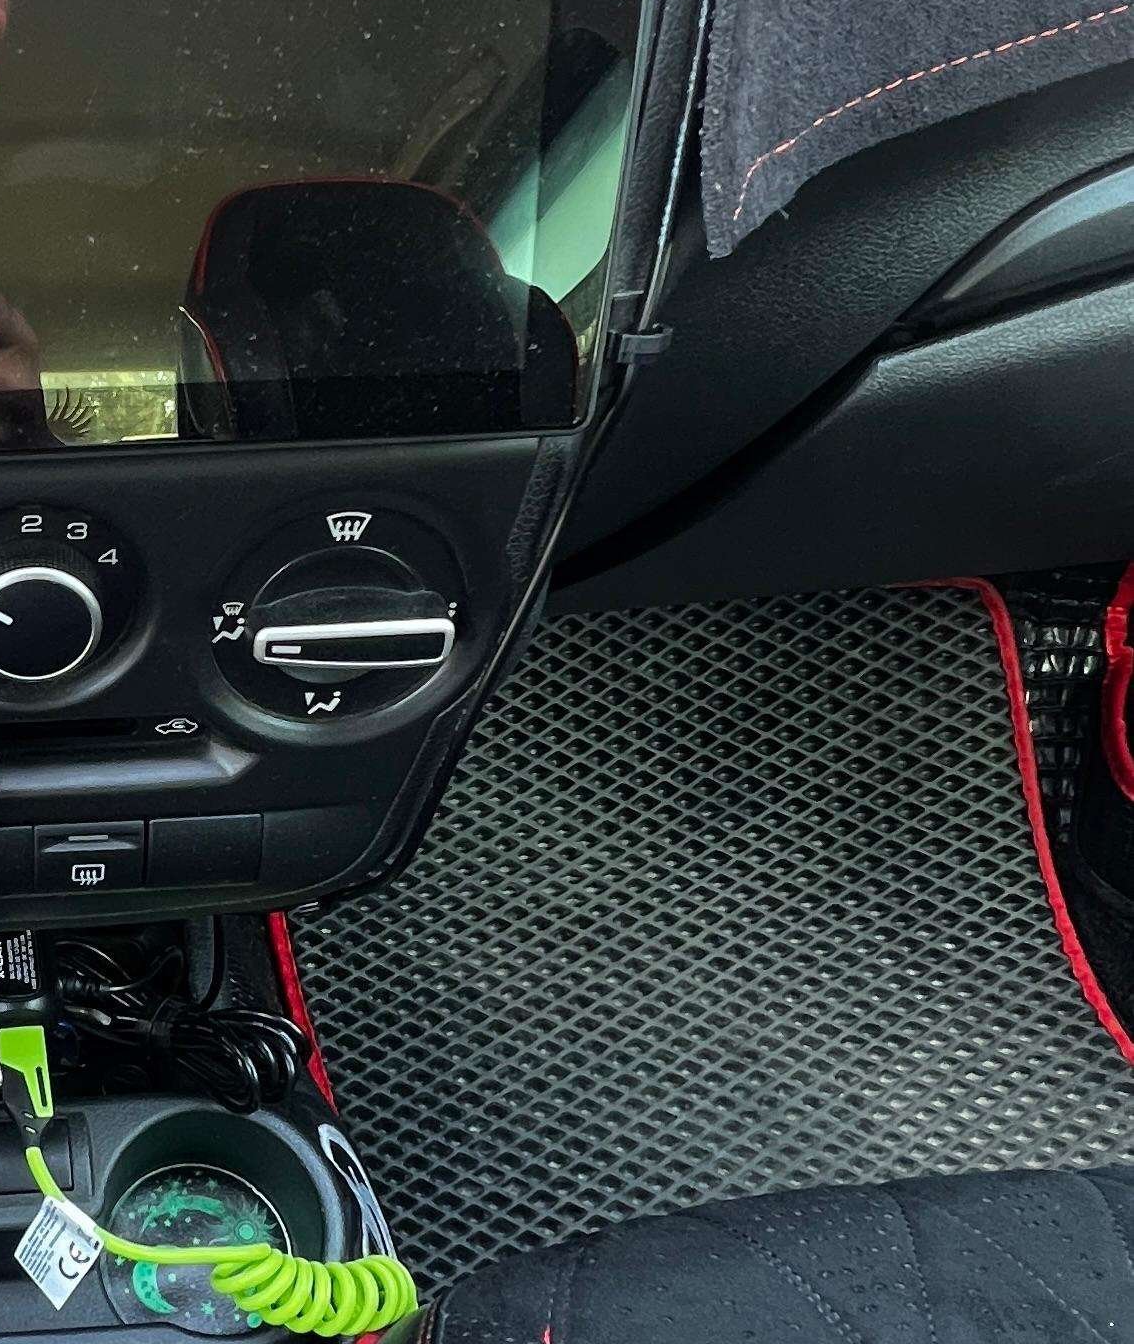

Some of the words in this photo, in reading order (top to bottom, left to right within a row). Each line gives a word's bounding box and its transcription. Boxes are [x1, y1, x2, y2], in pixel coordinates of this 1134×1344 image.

[21, 515, 43, 533] 2
[66, 522, 88, 540] 3
[97, 549, 119, 565] 4
